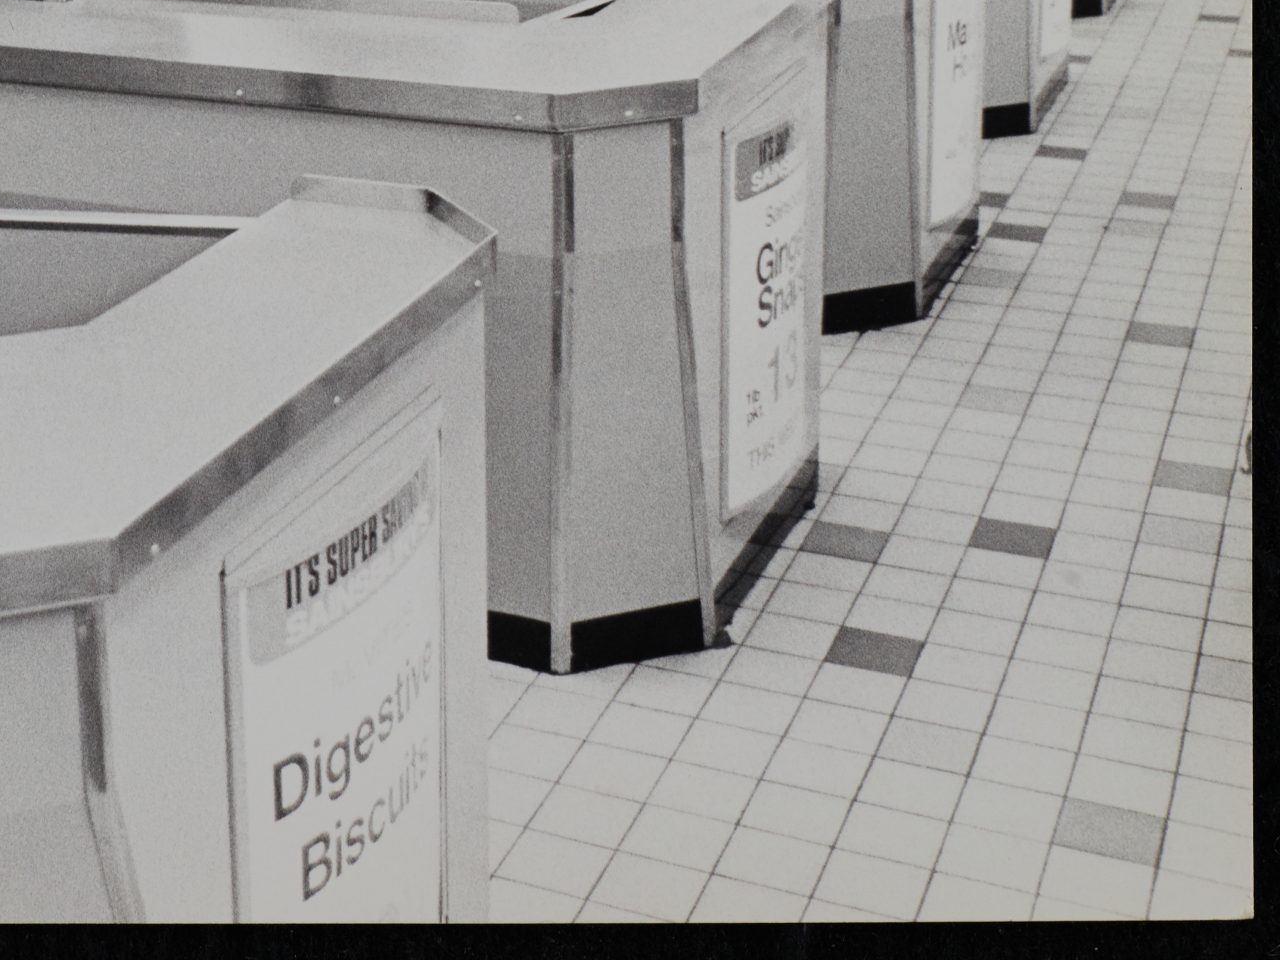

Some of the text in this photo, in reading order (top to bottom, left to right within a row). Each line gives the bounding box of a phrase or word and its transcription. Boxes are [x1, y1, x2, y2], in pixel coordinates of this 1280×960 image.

[285, 553, 320, 610] IT'S
[326, 512, 379, 586] SUPER
[272, 639, 432, 822] Digestive
[301, 735, 428, 903] Biscuits
